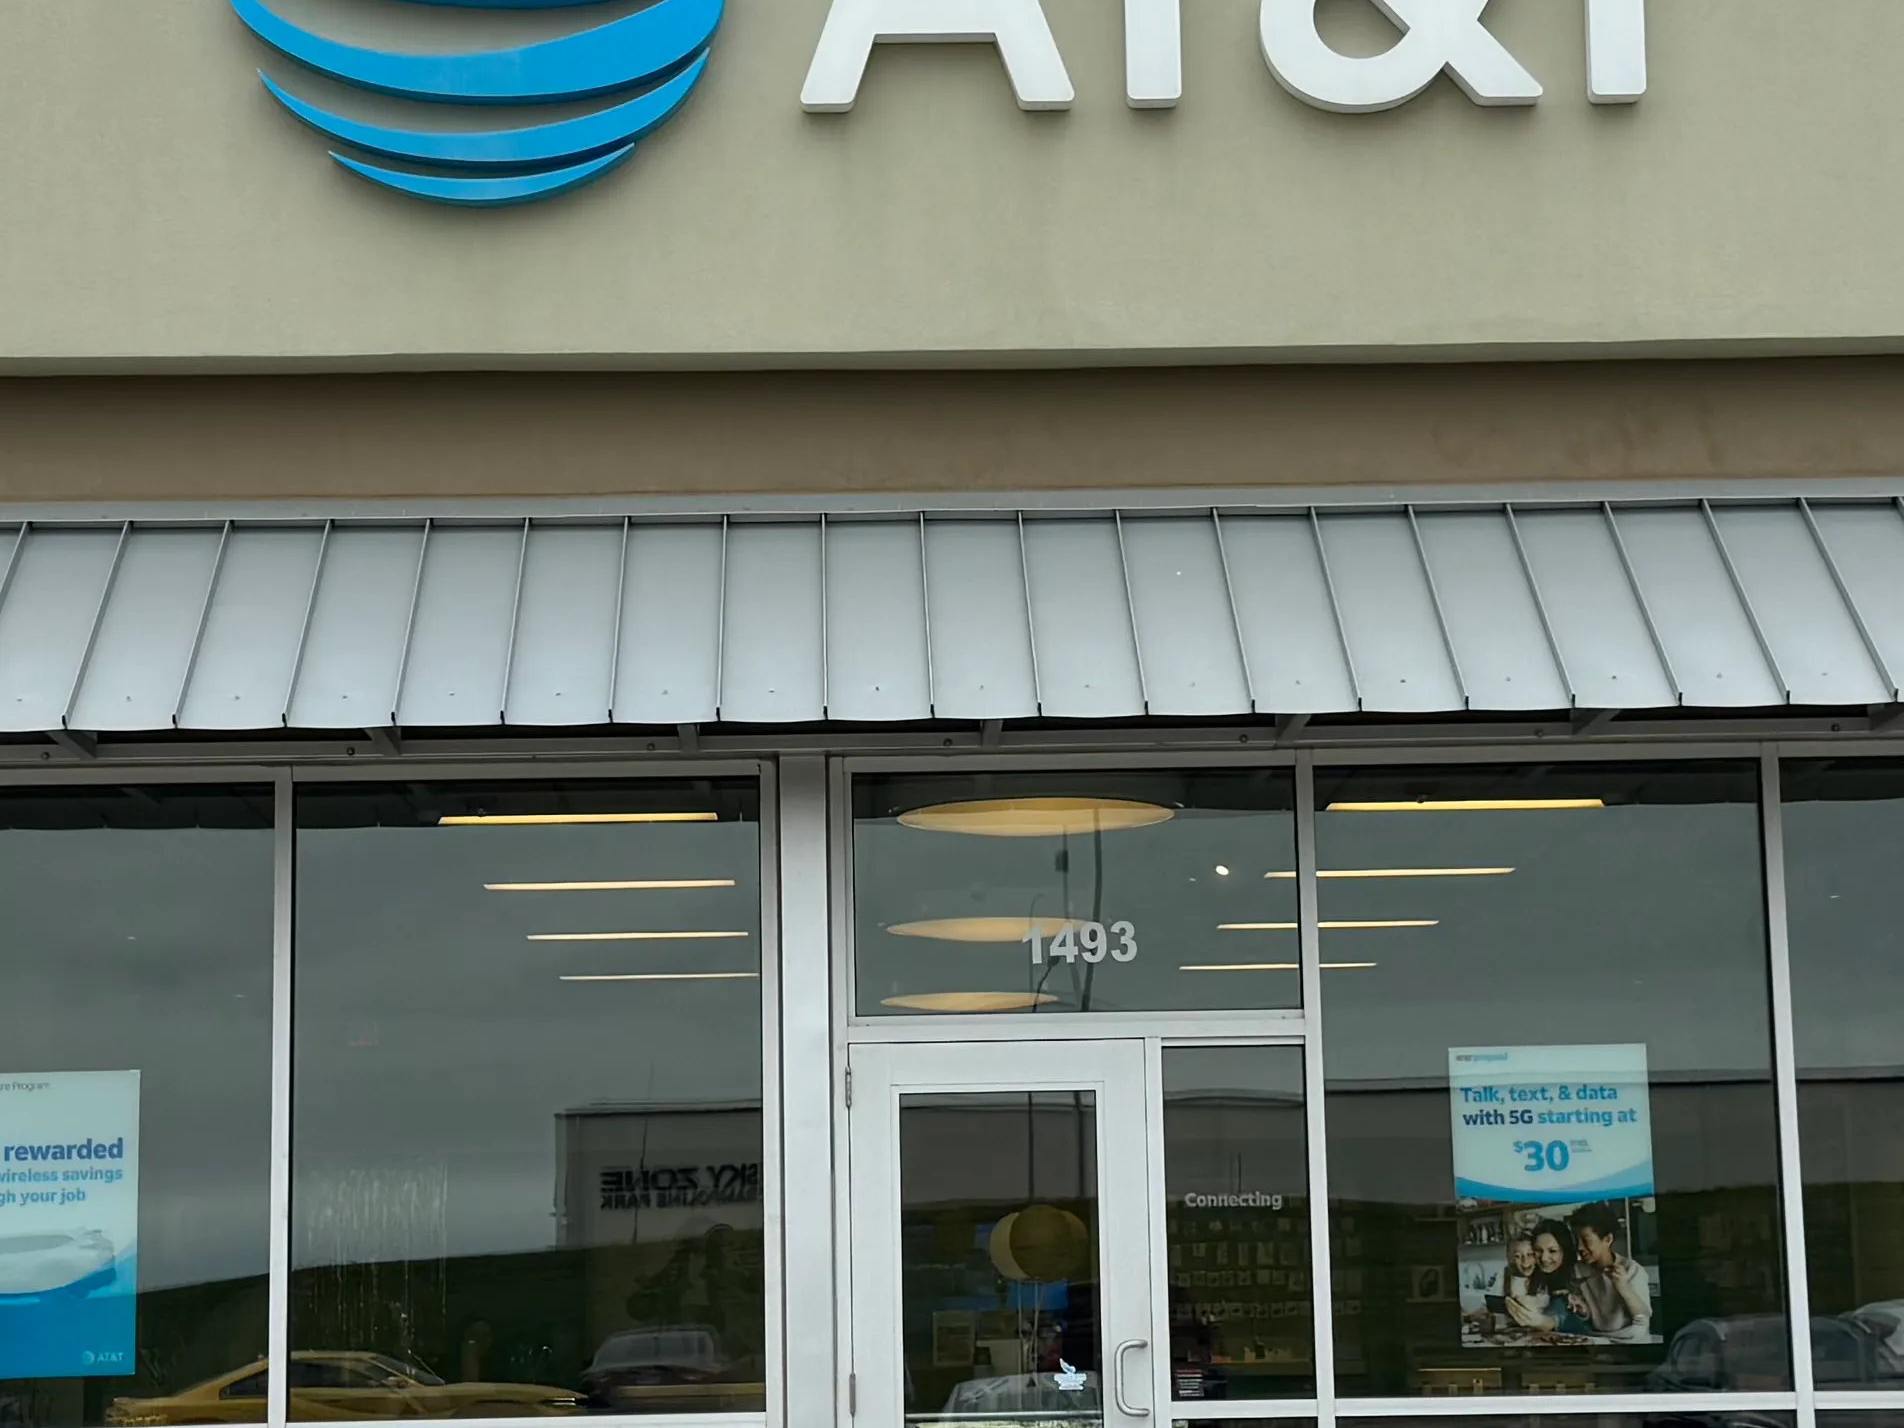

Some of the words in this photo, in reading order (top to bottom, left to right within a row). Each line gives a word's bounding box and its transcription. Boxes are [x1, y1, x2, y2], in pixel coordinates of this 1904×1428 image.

[1021, 920, 1138, 965] 1493
[1460, 1085, 1505, 1105] Talk,
[1509, 1085, 1554, 1103] text,
[1558, 1085, 1572, 1101] &
[1576, 1084, 1618, 1101] data
[1462, 1109, 1505, 1126] with
[1509, 1109, 1534, 1125] 5G
[1537, 1108, 1613, 1127] starting
[1617, 1108, 1637, 1123] at
[3, 1137, 124, 1162] rewarded
[1513, 1139, 1570, 1172] $30
[61, 1166, 124, 1183] savings
[19, 1190, 58, 1206] your
[58, 1188, 86, 1205] job
[1184, 1191, 1283, 1210] Connecting
[97, 1351, 124, 1363] AT&T
